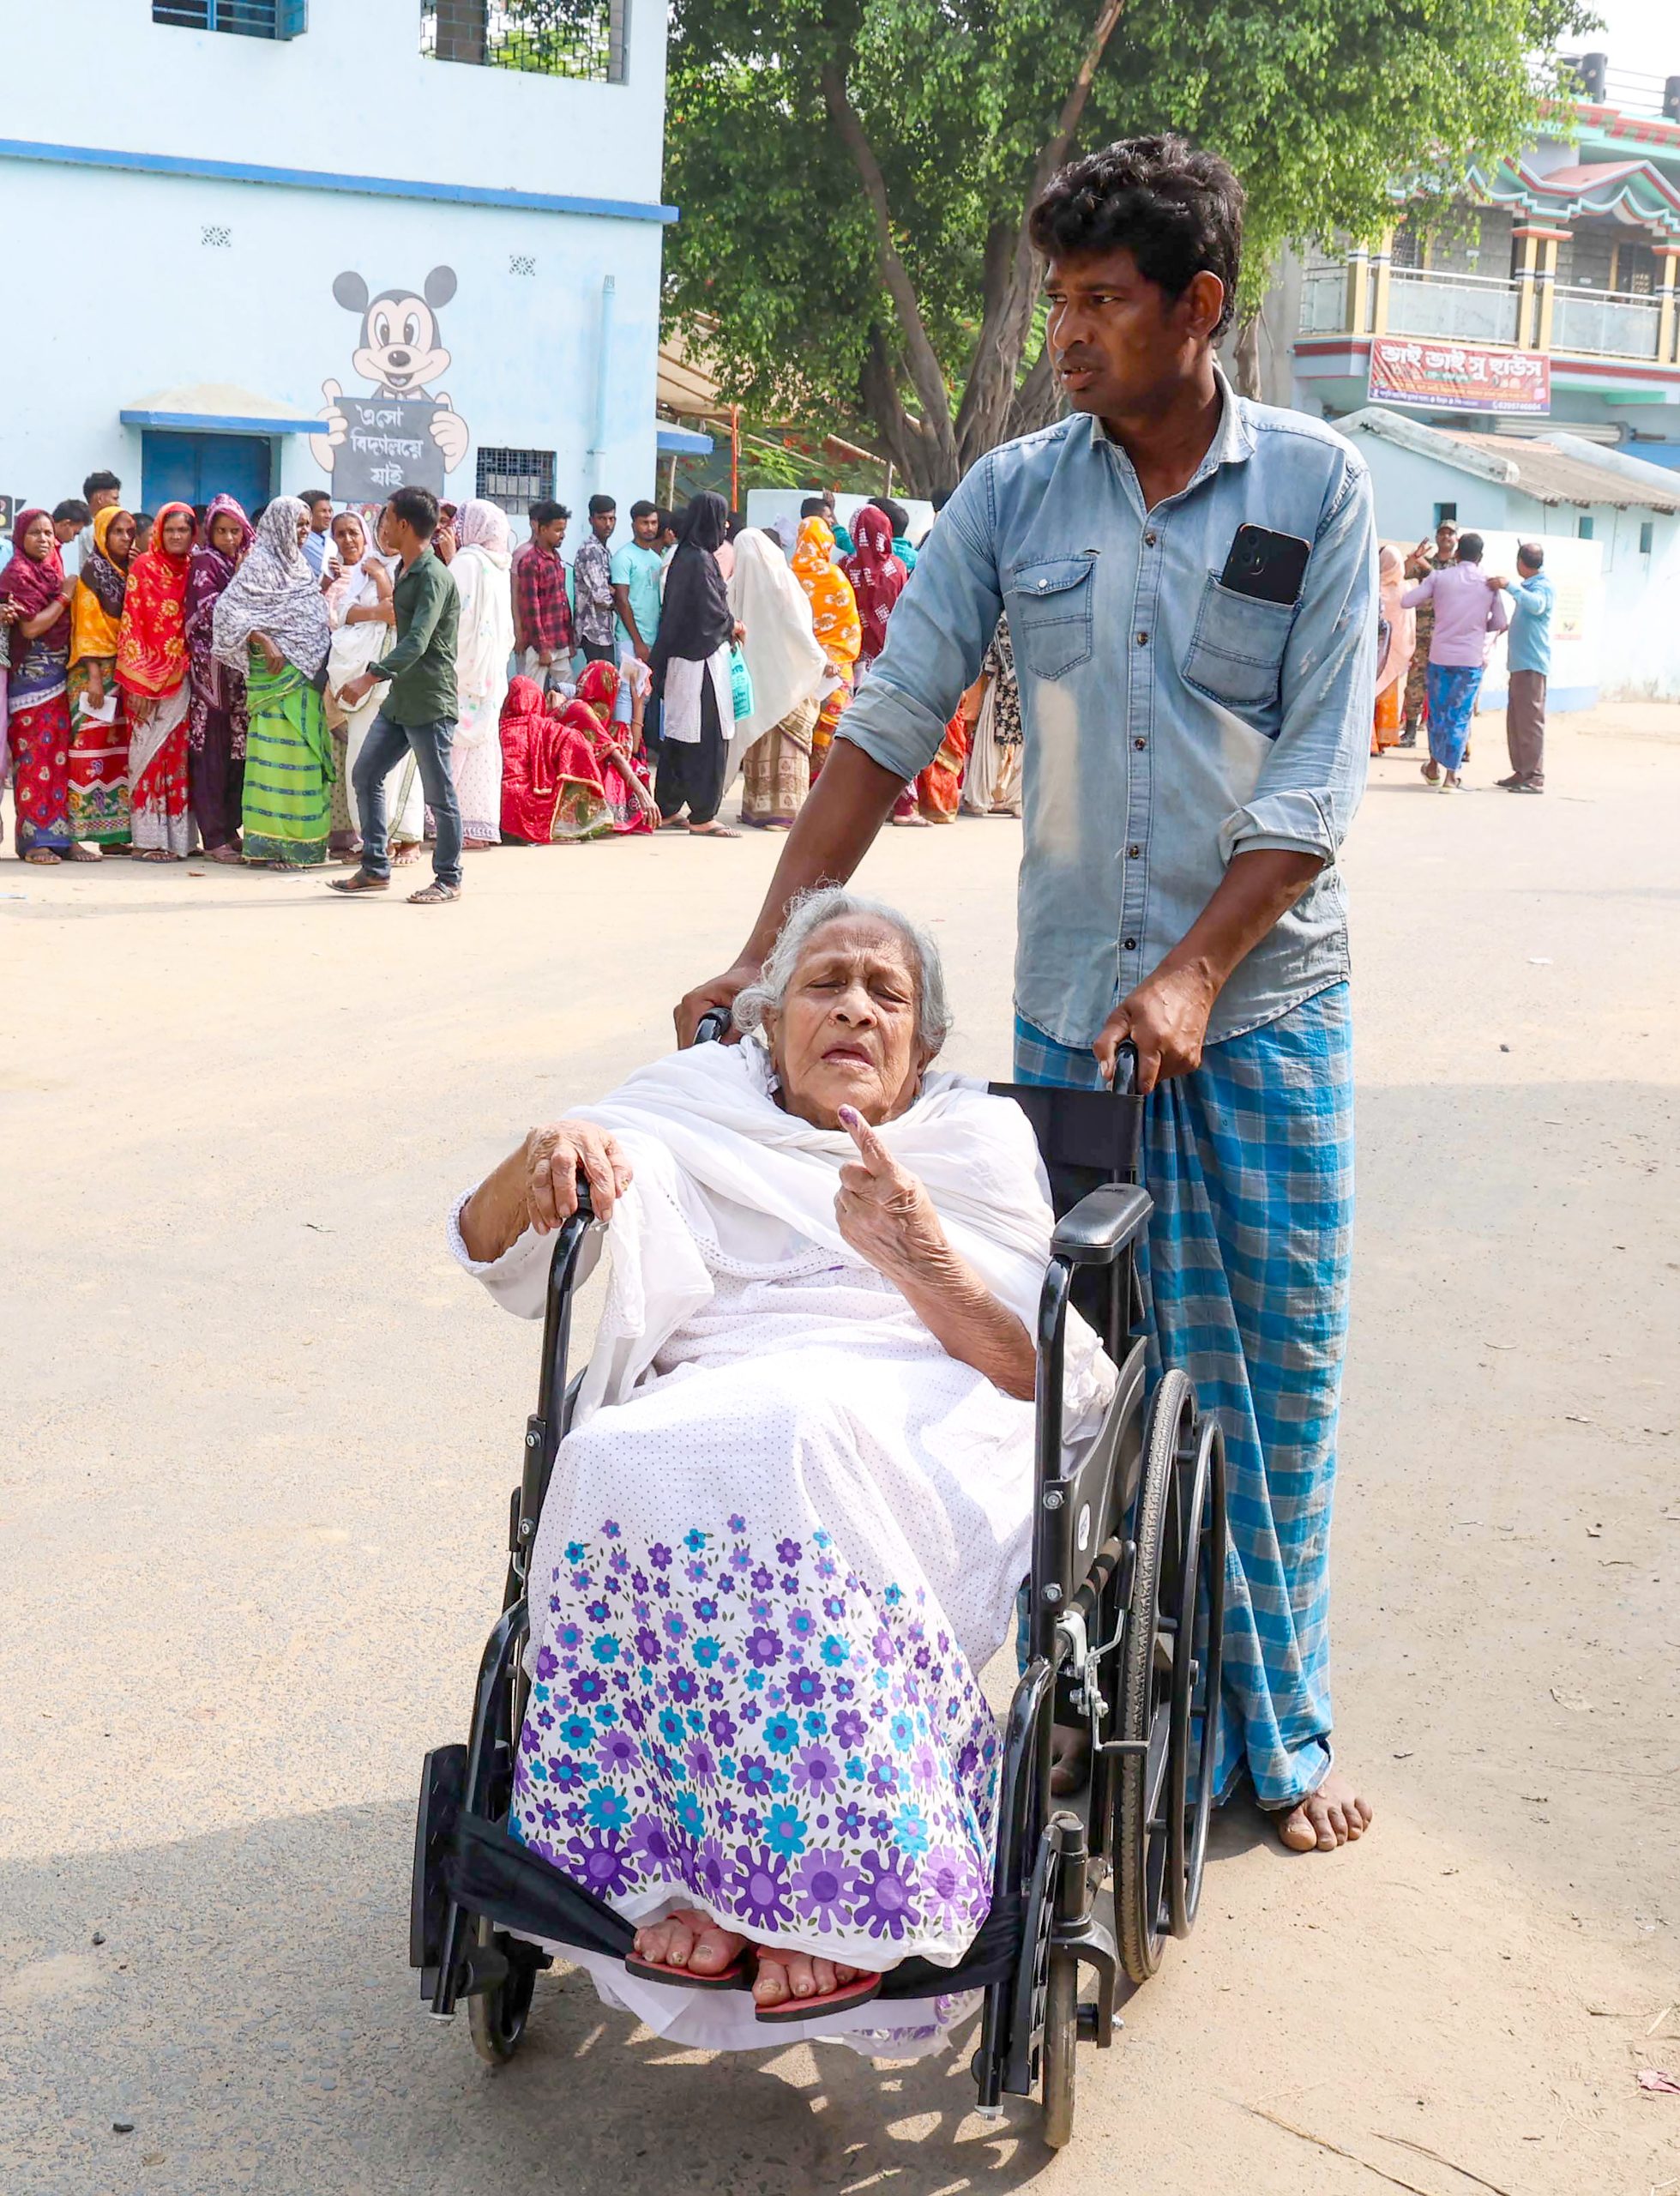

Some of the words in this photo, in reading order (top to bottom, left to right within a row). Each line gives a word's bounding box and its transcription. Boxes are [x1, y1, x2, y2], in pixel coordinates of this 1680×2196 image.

[1380, 343, 1423, 367] ভাই
[1424, 348, 1466, 372] ভাই
[1467, 355, 1489, 382] সু
[1489, 354, 1543, 377] হাউস
[354, 404, 404, 428] এসো
[350, 426, 424, 460] বিদ্যালয়ে
[370, 461, 405, 488] যাই
